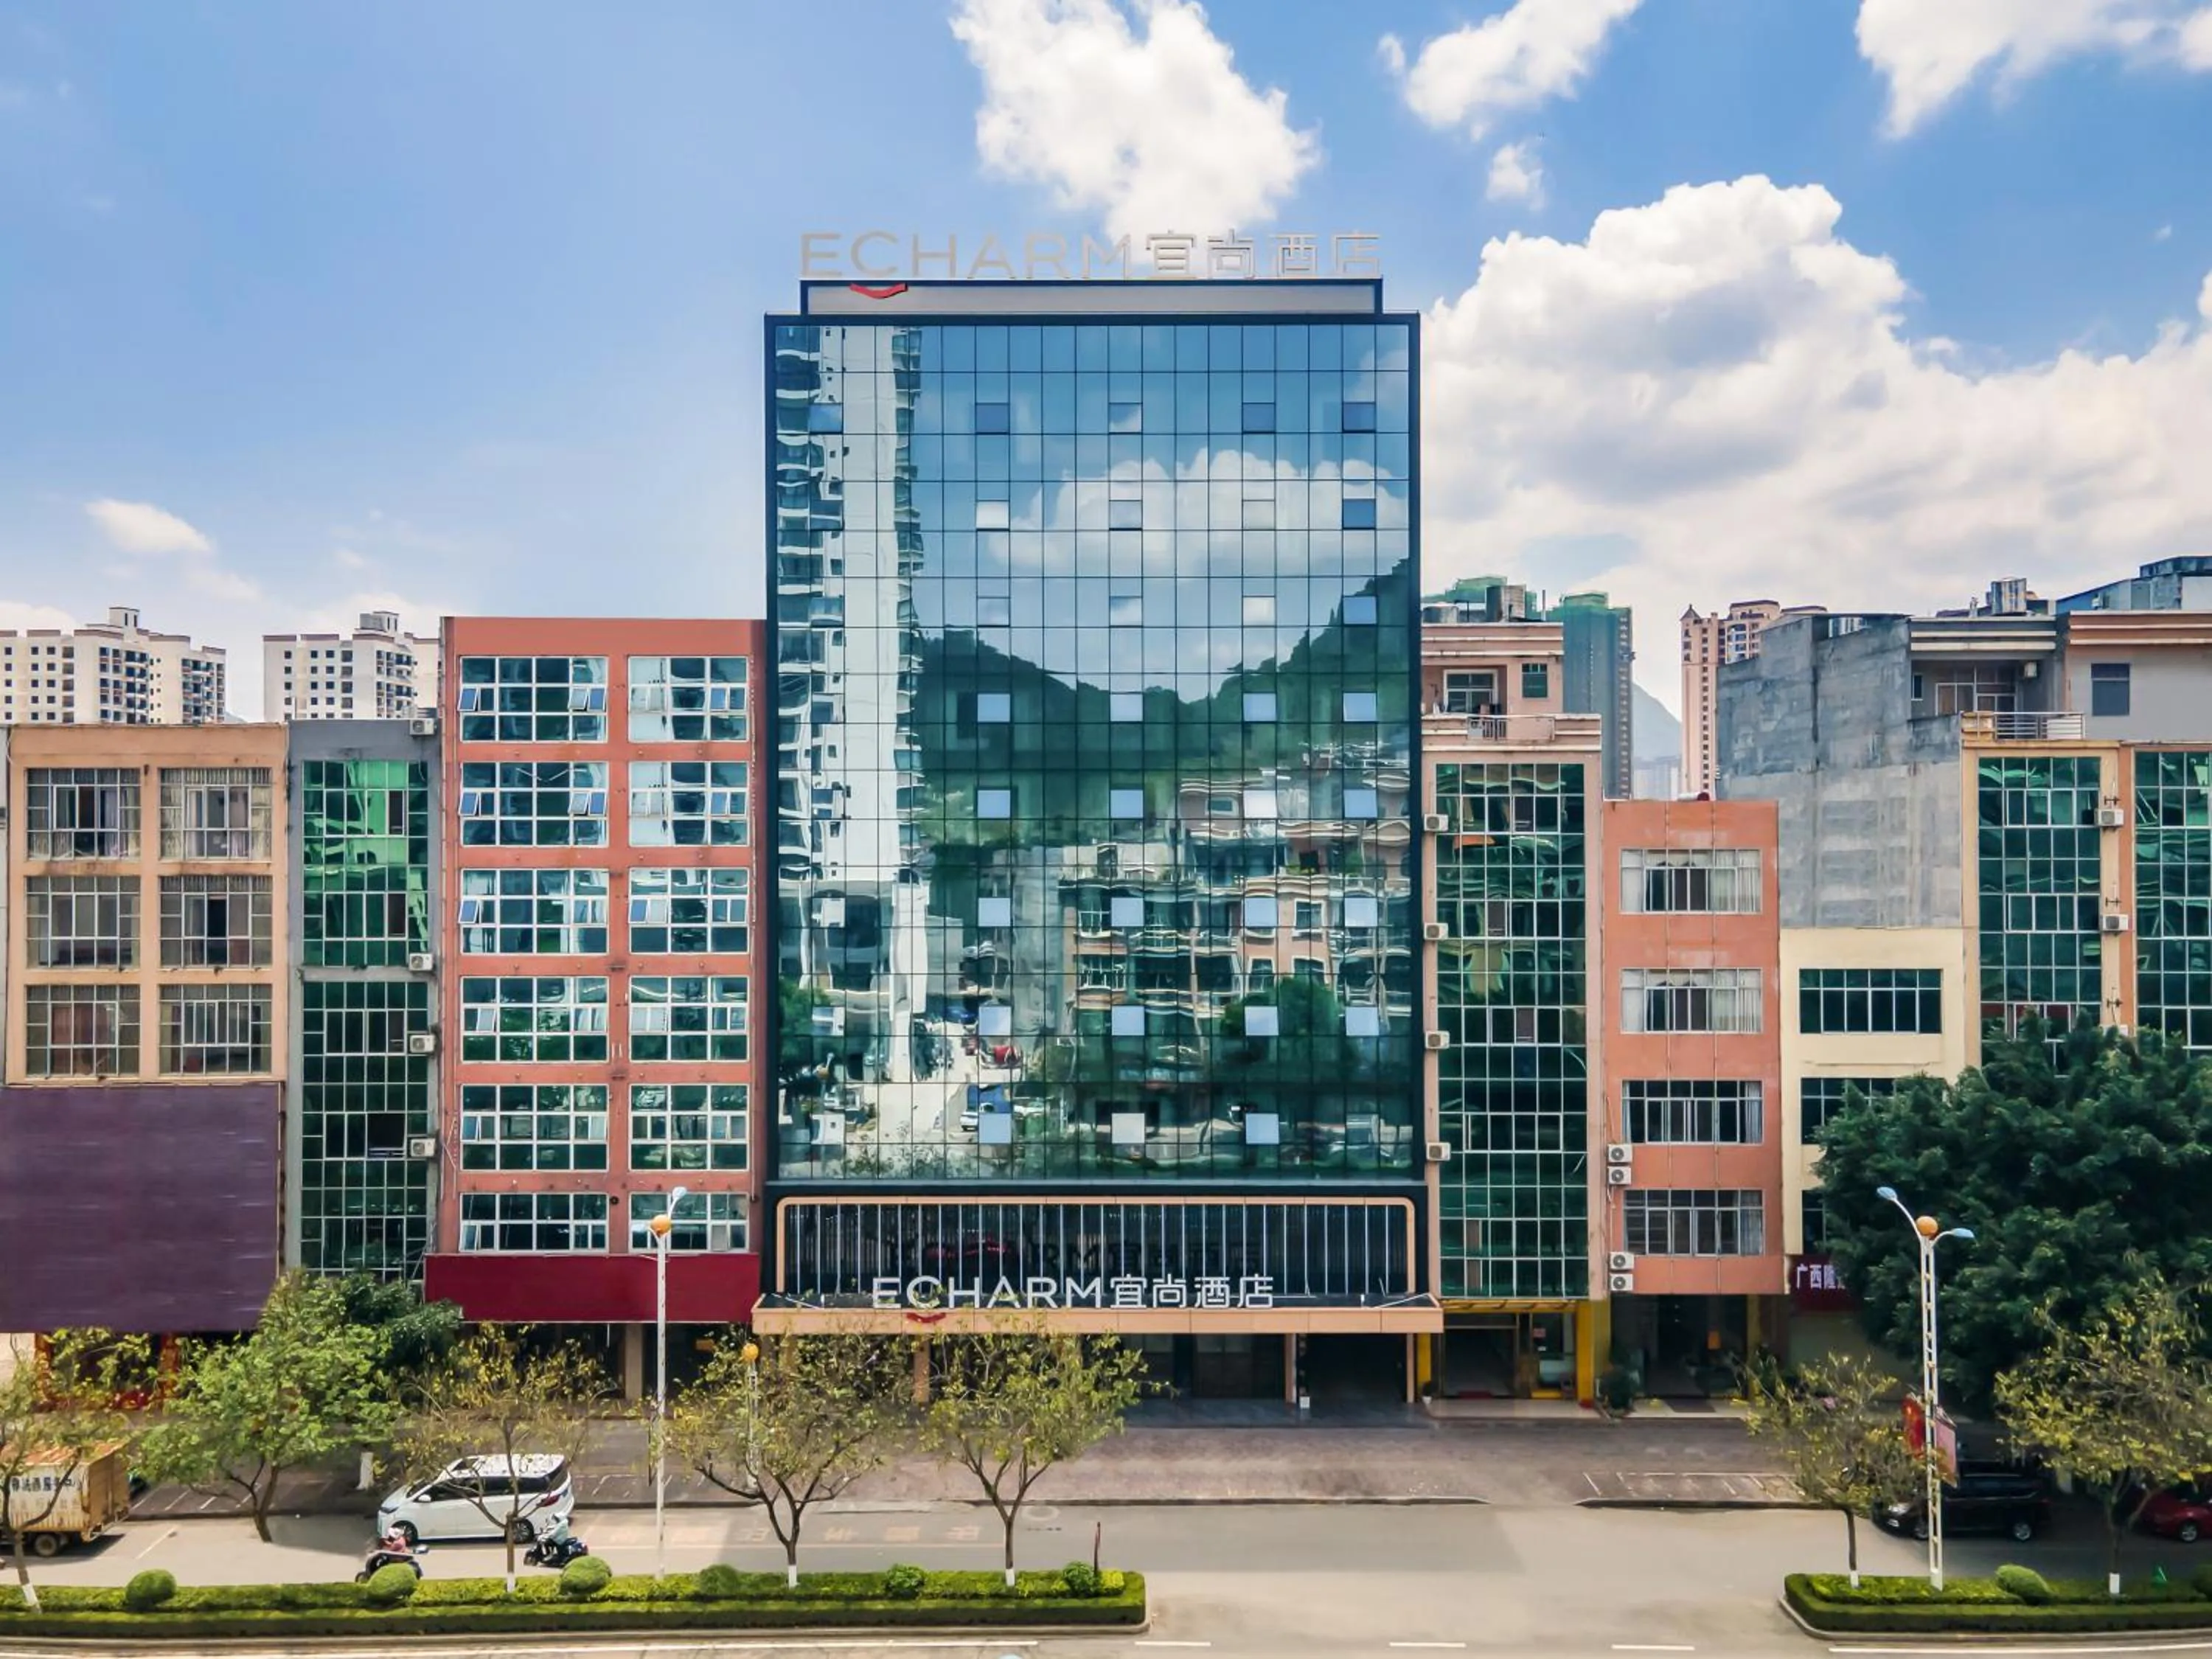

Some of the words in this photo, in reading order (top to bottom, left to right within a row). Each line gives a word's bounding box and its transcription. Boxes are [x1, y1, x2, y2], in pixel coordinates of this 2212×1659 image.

[801, 231, 1130, 279] ECHARM
[1146, 229, 1380, 279] 宜尚酒店
[872, 1275, 1102, 1310] ECHARM
[1110, 1273, 1274, 1309] 宜尚酒店
[1796, 1263, 1845, 1290] 广西隆
